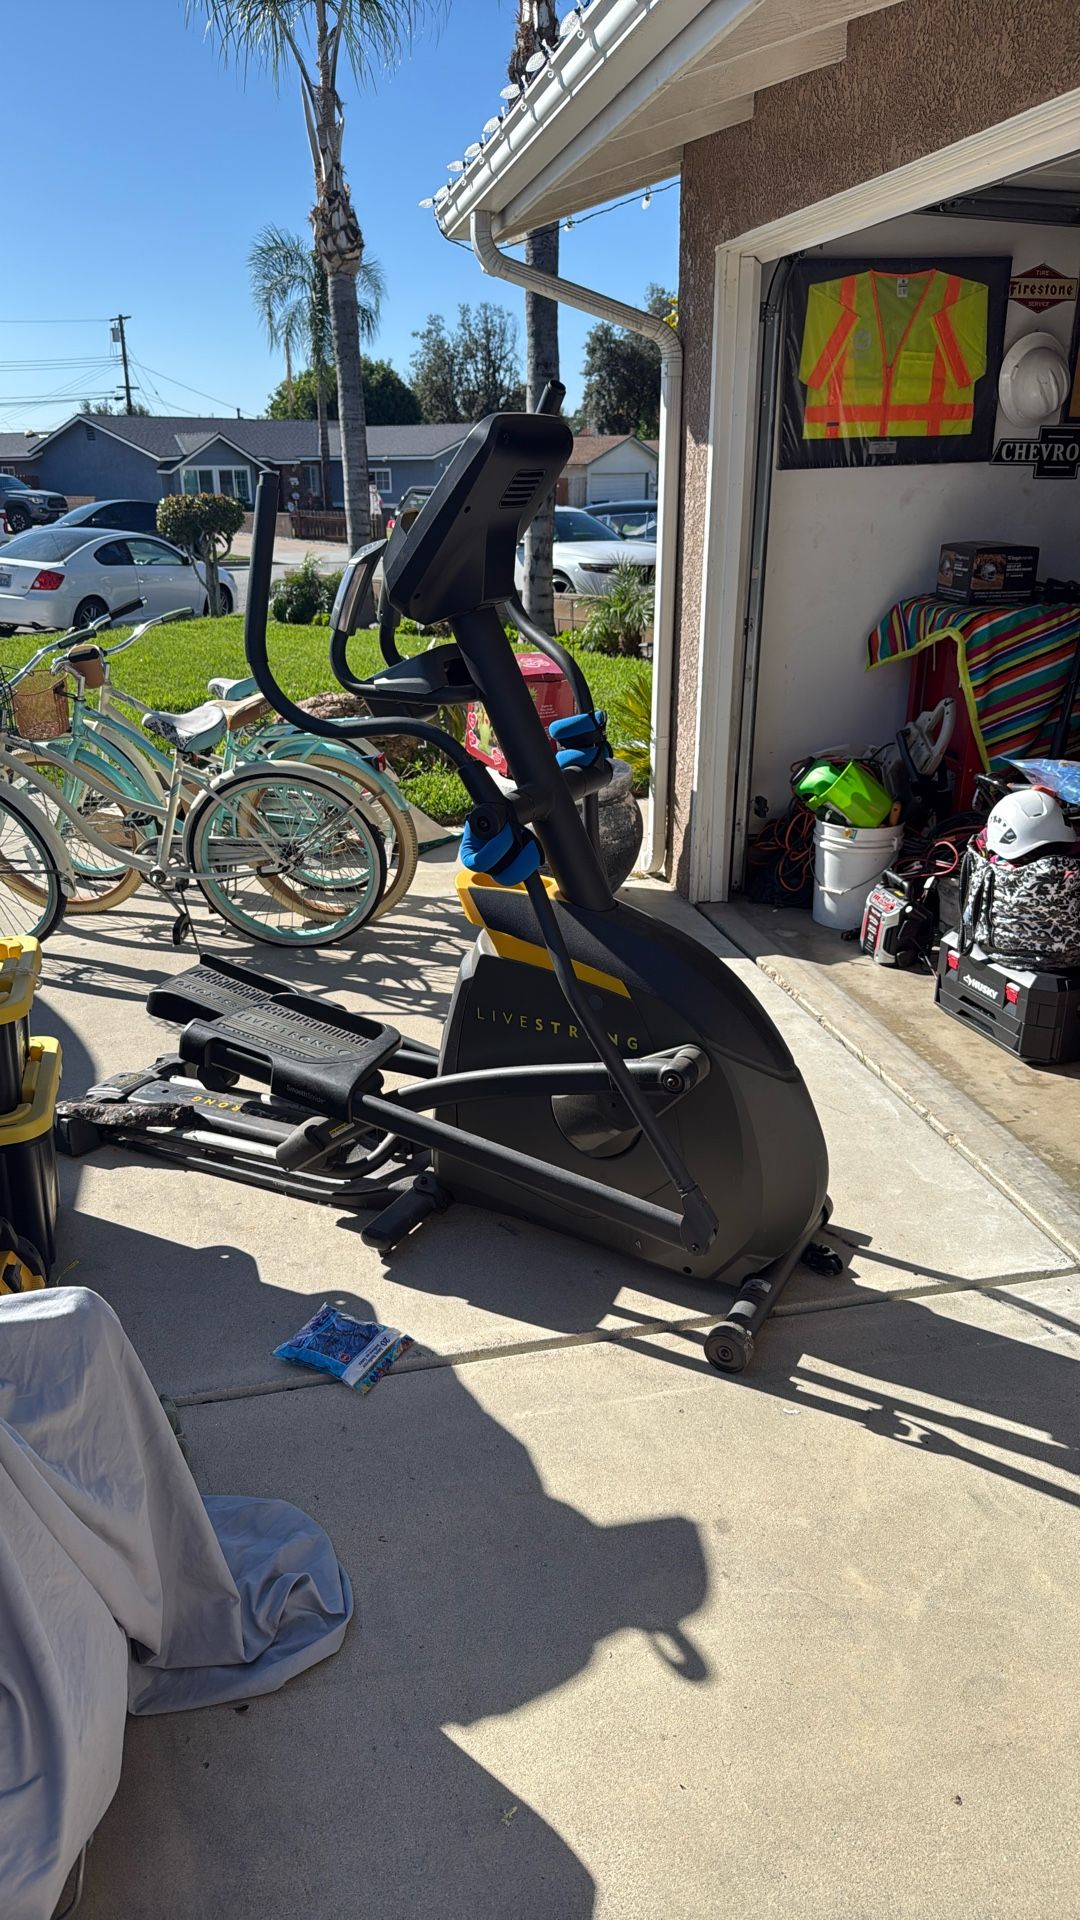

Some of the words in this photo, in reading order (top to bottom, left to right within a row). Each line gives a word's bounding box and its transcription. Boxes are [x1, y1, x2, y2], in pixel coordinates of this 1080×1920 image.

[1009, 280, 1074, 297] Firestone
[1001, 442, 1080, 461] CHEVRO
[971, 979, 999, 1000] HUSKY
[237, 1013, 337, 1052] LIVESTRONG
[476, 1007, 639, 1050] LIVESTRNG
